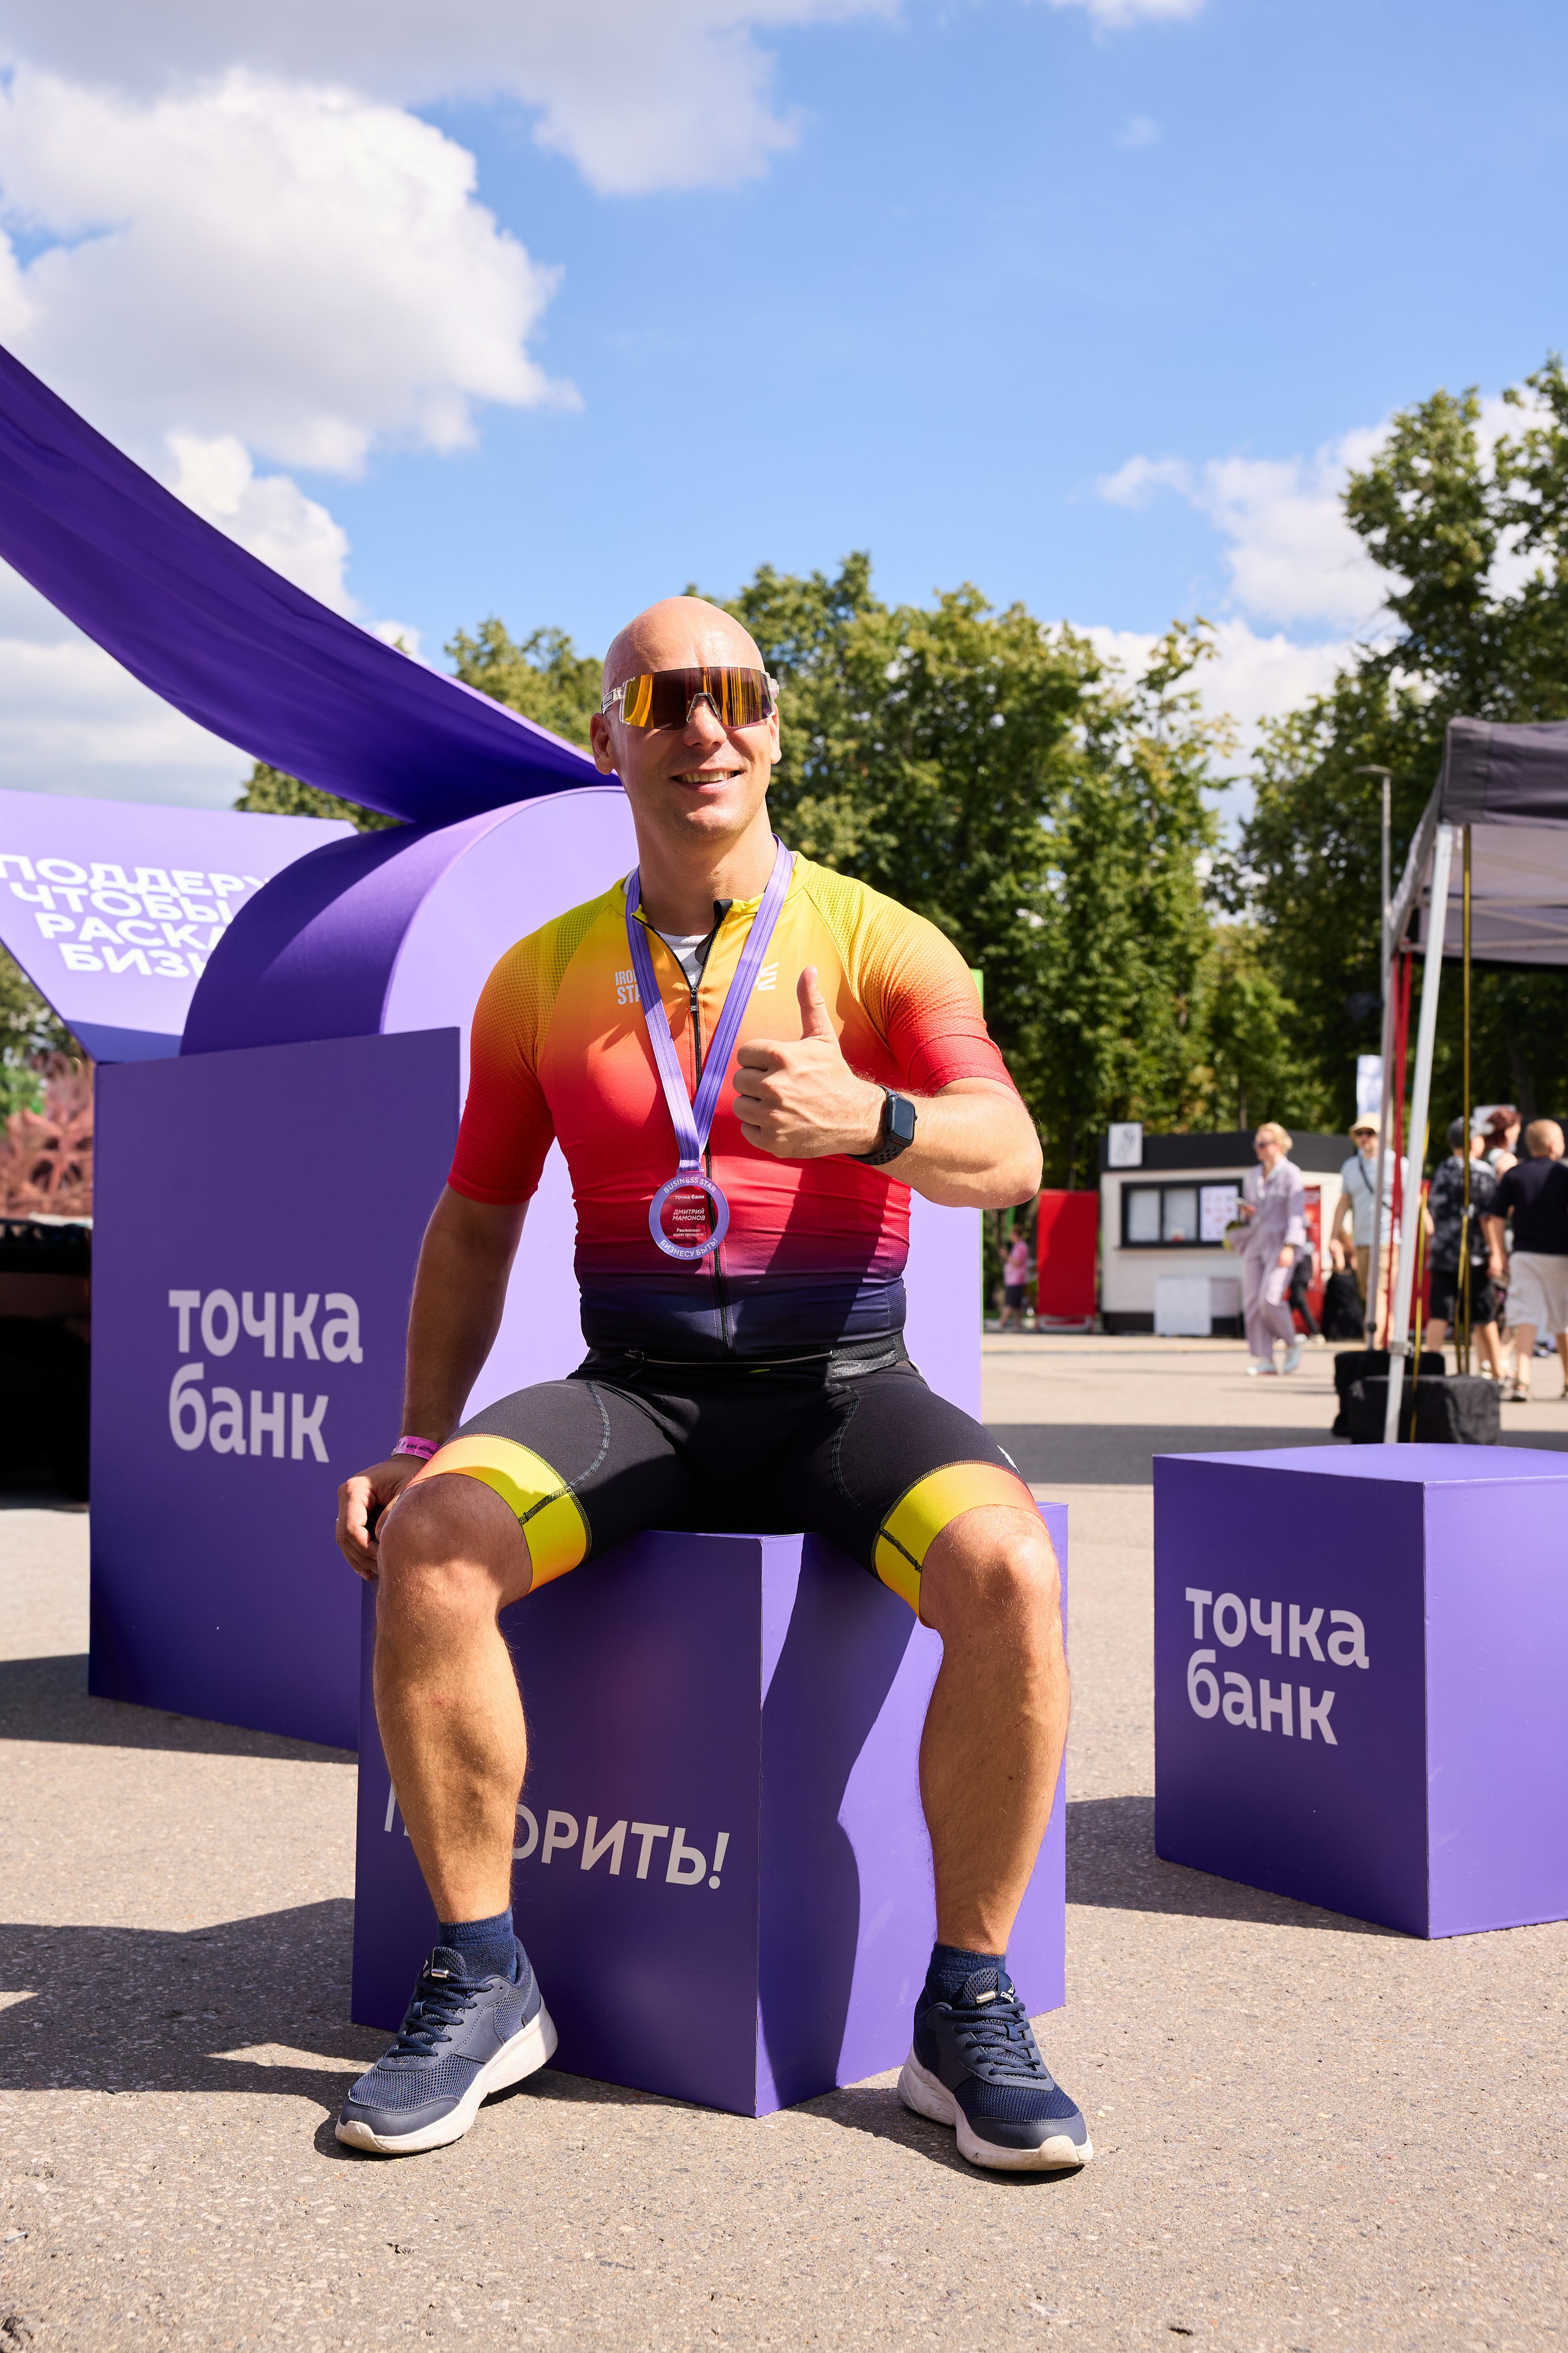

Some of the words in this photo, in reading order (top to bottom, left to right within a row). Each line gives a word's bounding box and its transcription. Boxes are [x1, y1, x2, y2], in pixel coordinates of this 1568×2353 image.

[9, 882, 234, 924] ЧТОБЫ
[617, 984, 640, 1005] STA
[663, 1176, 699, 1193] BUSINESS
[699, 1179, 717, 1193] STAR
[660, 1239, 695, 1257] БИЗНЕСУ
[695, 1237, 718, 1256] БЫТЬ!
[168, 1288, 363, 1364] точка
[168, 1362, 330, 1464] банк
[1185, 1587, 1370, 1669] точка
[1186, 1649, 1338, 1746] банк
